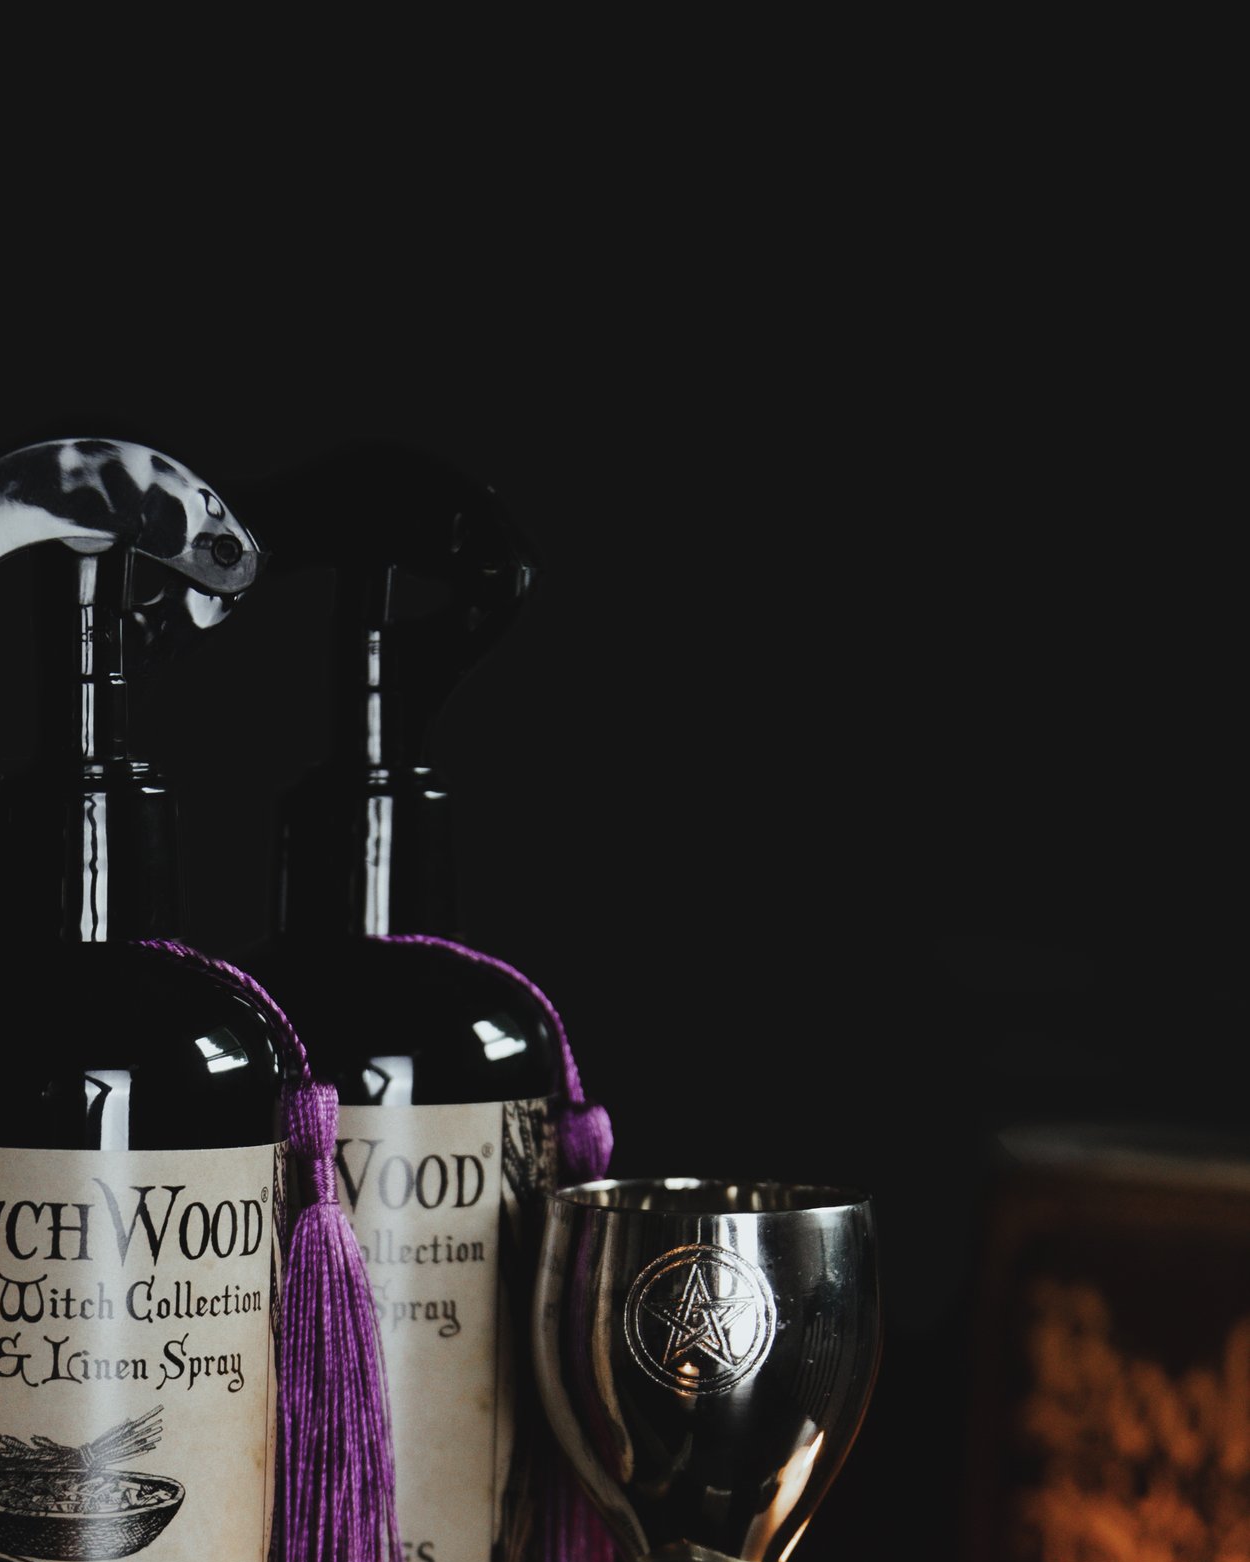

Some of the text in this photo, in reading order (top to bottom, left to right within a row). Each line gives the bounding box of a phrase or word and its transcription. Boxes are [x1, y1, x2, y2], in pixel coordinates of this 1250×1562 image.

[126, 1275, 262, 1323] Collection
[41, 1334, 149, 1387] Linen
[156, 1333, 245, 1393] Spray
